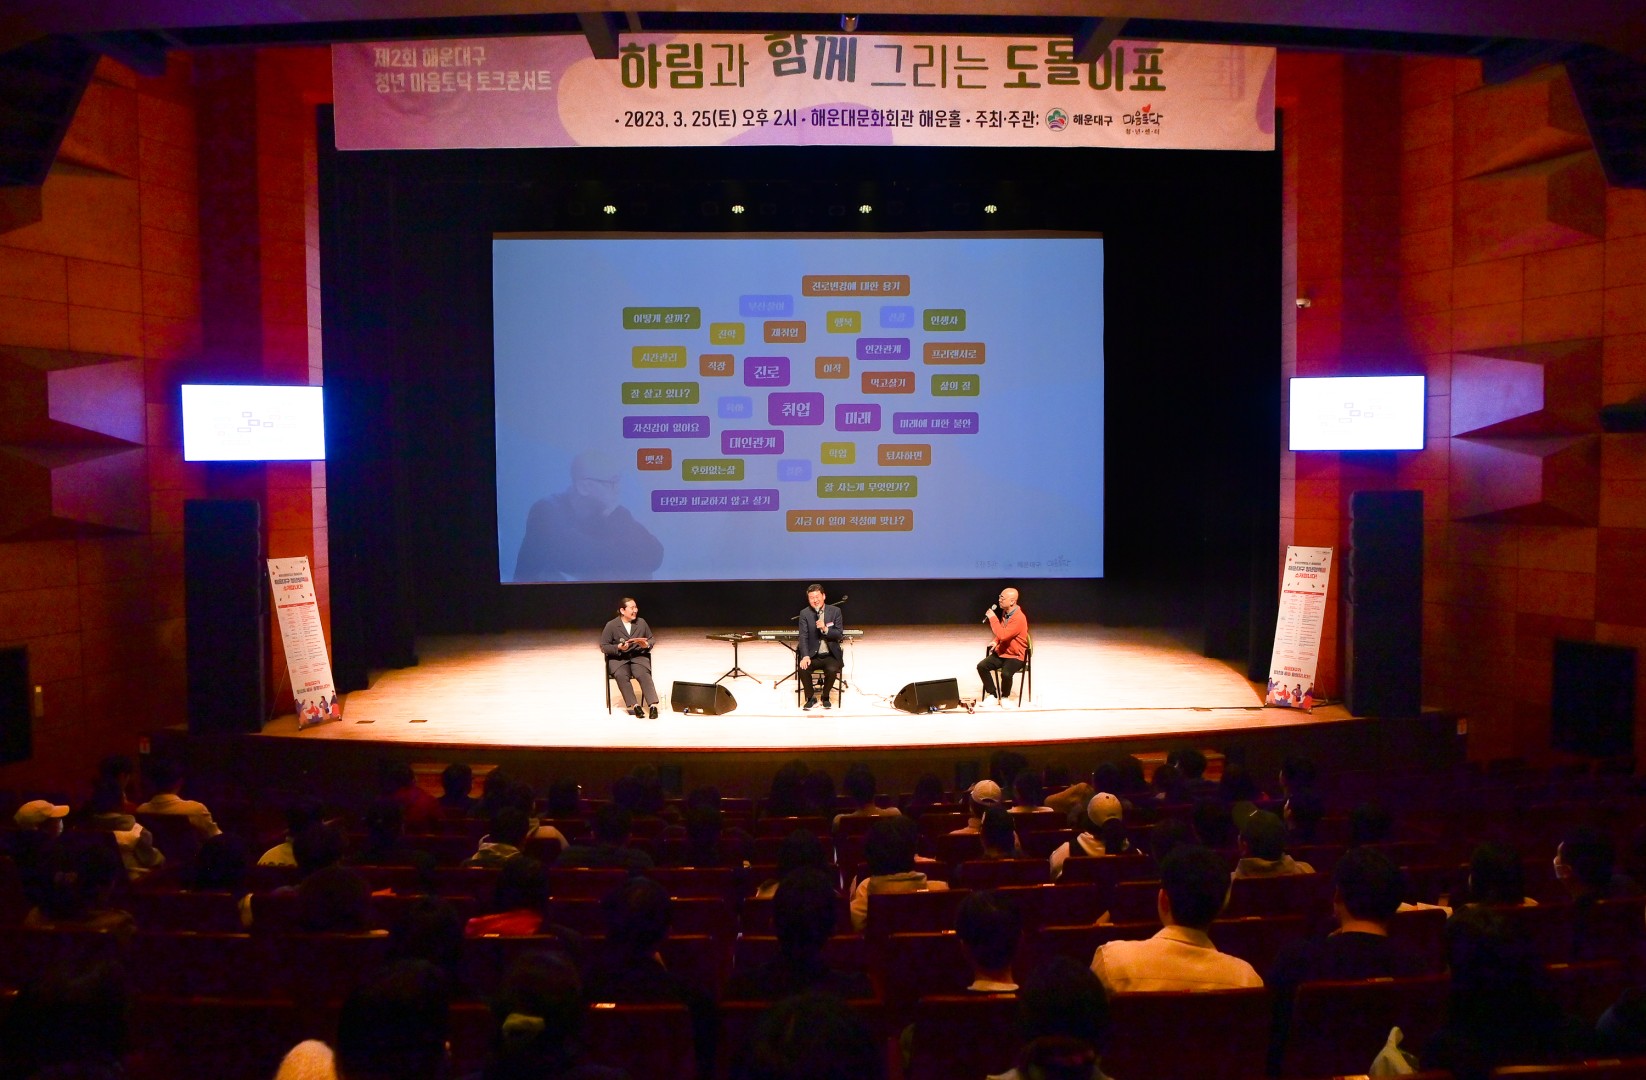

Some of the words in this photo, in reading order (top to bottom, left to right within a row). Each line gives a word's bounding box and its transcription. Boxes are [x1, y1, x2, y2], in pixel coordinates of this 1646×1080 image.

[374, 47, 417, 68] 제2회
[422, 46, 486, 67] 해운대구
[620, 42, 749, 89] 하림과
[764, 34, 857, 82] 함께
[870, 43, 989, 89] 그리는
[1003, 40, 1167, 92] 도돌이표
[376, 71, 405, 93] 청년
[410, 71, 472, 93] 마음토닥
[476, 70, 552, 91] 토크콘서트
[692, 109, 737, 128] 25(토)
[742, 108, 768, 127] 오후
[773, 109, 797, 127] 2시
[811, 108, 914, 128] 해운대문화회관
[919, 109, 961, 128] 해운홀
[1072, 113, 1113, 126] 해운대구
[860, 281, 879, 291] 대한
[883, 281, 900, 291] 용기
[633, 314, 661, 323] 어떻게
[665, 313, 690, 323] 살까?
[771, 328, 799, 337] 재취업
[865, 344, 901, 354] 인간관계
[641, 353, 677, 362] 시간관리
[708, 361, 726, 371] 직장
[823, 363, 841, 373] 이직
[754, 366, 780, 379] 진로
[870, 378, 906, 388] 먹고살기
[631, 389, 640, 399] 잘
[644, 389, 662, 398] 살고
[781, 402, 811, 417] 취업
[845, 411, 871, 425] 미래
[633, 423, 669, 433] 자신감이
[673, 423, 700, 433] 없어요
[900, 419, 928, 428] 미래에
[931, 419, 950, 429] 대한
[953, 419, 971, 429] 불안
[730, 437, 776, 449] 대인관계
[885, 451, 922, 461] 퇴사하면
[824, 482, 834, 492] 잘
[837, 482, 865, 492] 사는게
[868, 482, 910, 492] 무엇인가?
[660, 497, 688, 506] 타인과
[692, 496, 728, 506] 비교하지
[731, 496, 749, 505] 않고
[752, 496, 771, 505] 살기
[795, 516, 812, 526] 지금
[816, 516, 825, 526] 이
[828, 516, 846, 526] 일이
[850, 516, 877, 526] 적성에
[880, 516, 905, 525] 맞나?
